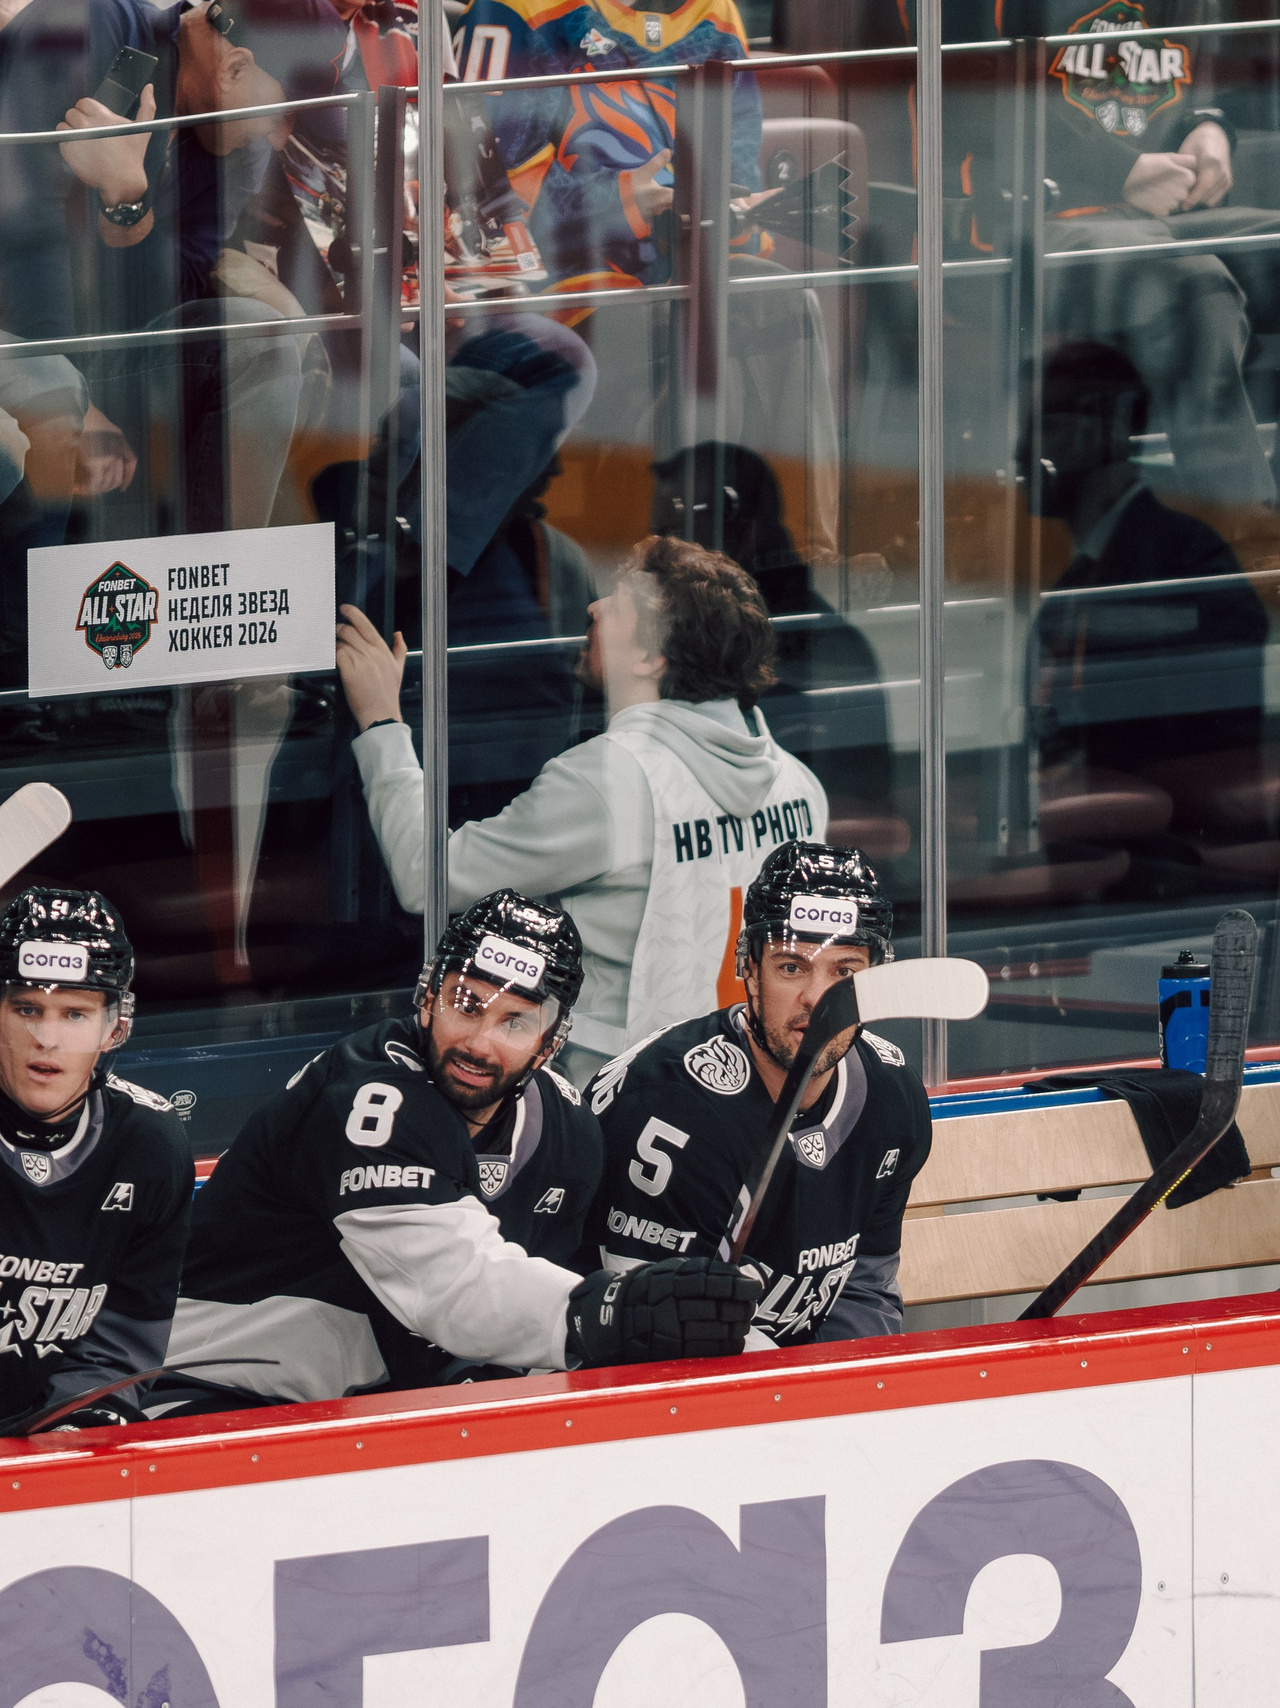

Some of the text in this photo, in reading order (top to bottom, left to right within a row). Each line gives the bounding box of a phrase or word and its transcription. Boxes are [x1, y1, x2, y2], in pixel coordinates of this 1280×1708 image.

[97, 578, 137, 593] FONBET
[168, 563, 230, 591] FONBET
[79, 591, 157, 626] ALL STAR
[168, 588, 290, 623] НЕДЕЛЯ ЗВЕЗД
[168, 620, 278, 652] ХОККЕЯ 2026
[673, 797, 813, 863] HB TV PHOTO
[794, 906, 853, 925] согаз
[22, 952, 84, 969] согаз
[481, 946, 539, 978] согаз
[345, 1082, 403, 1147] 8
[628, 1116, 690, 1197] 5
[339, 1165, 436, 1196] FONBET
[607, 1206, 698, 1253] ONBET
[797, 1233, 860, 1275] FONBET
[756, 1262, 813, 1324] LL
[15, 1284, 108, 1342] STAR
